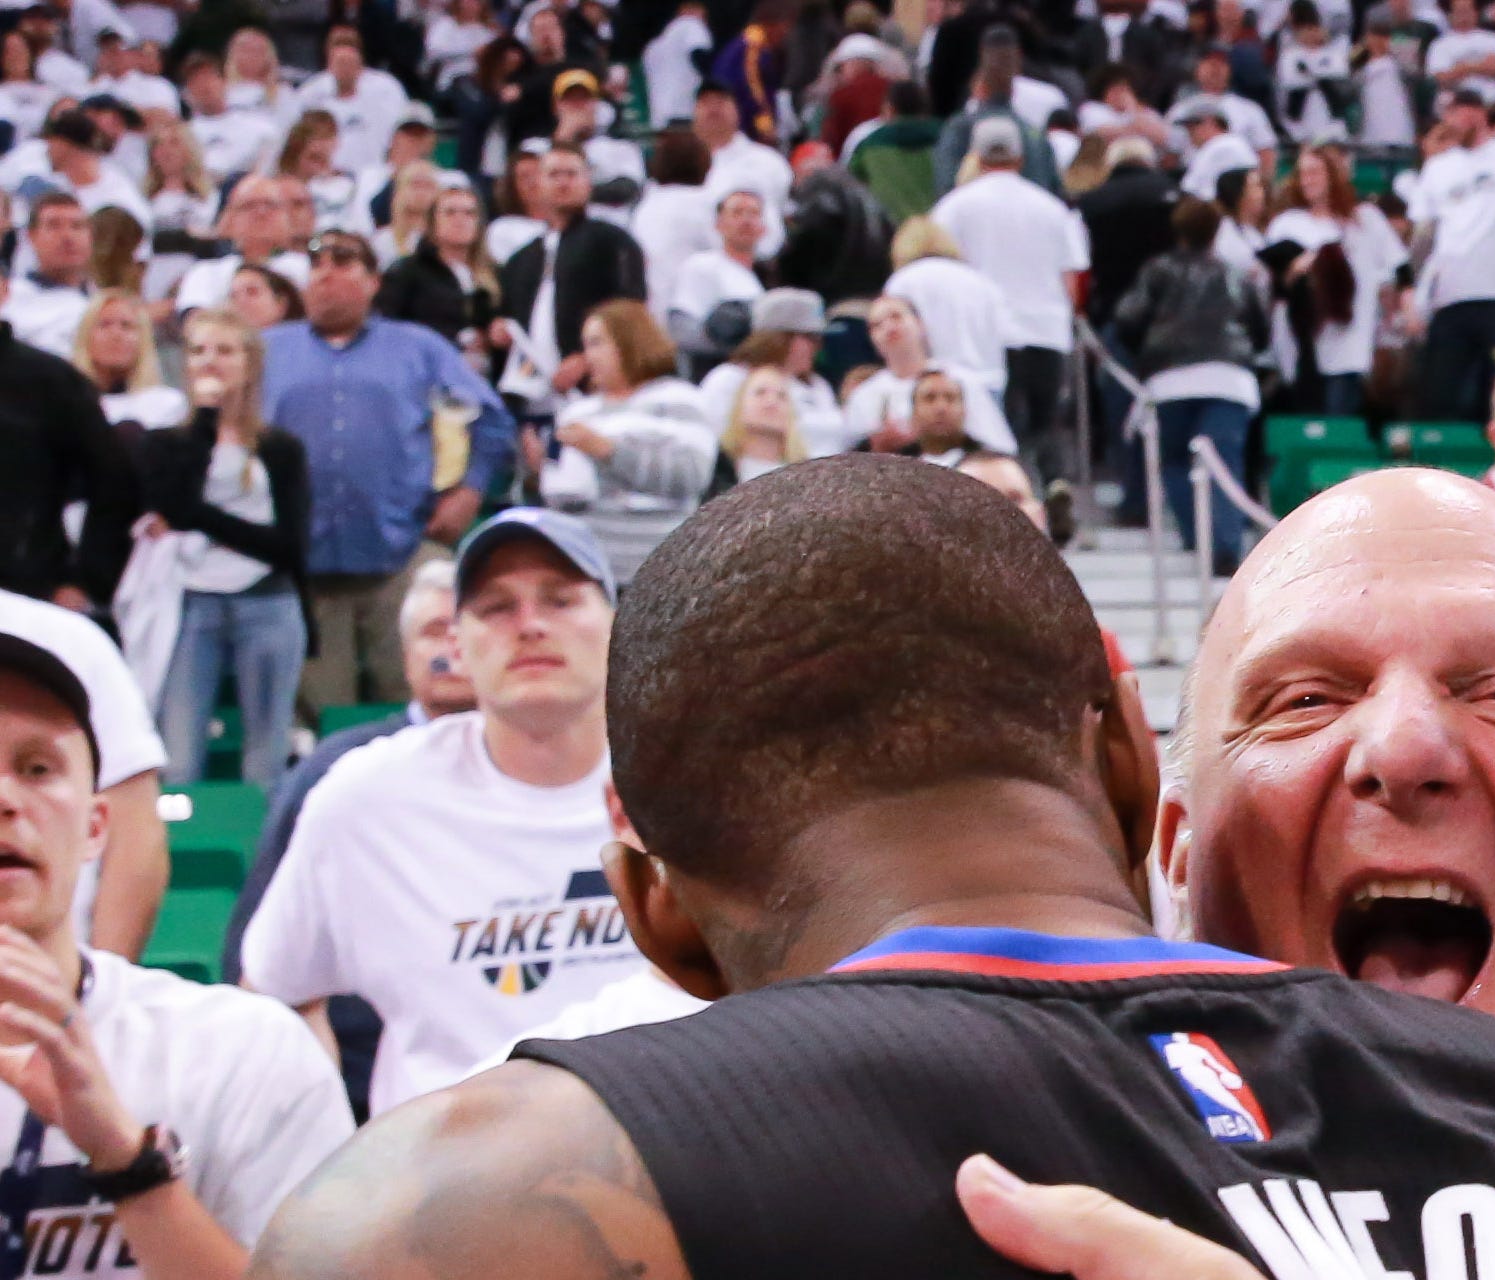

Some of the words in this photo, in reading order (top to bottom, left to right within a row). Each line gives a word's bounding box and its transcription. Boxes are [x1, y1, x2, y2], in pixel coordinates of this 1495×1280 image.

[451, 911, 563, 963] TAKE
[567, 906, 627, 948] NO
[1206, 1114, 1253, 1138] NBA
